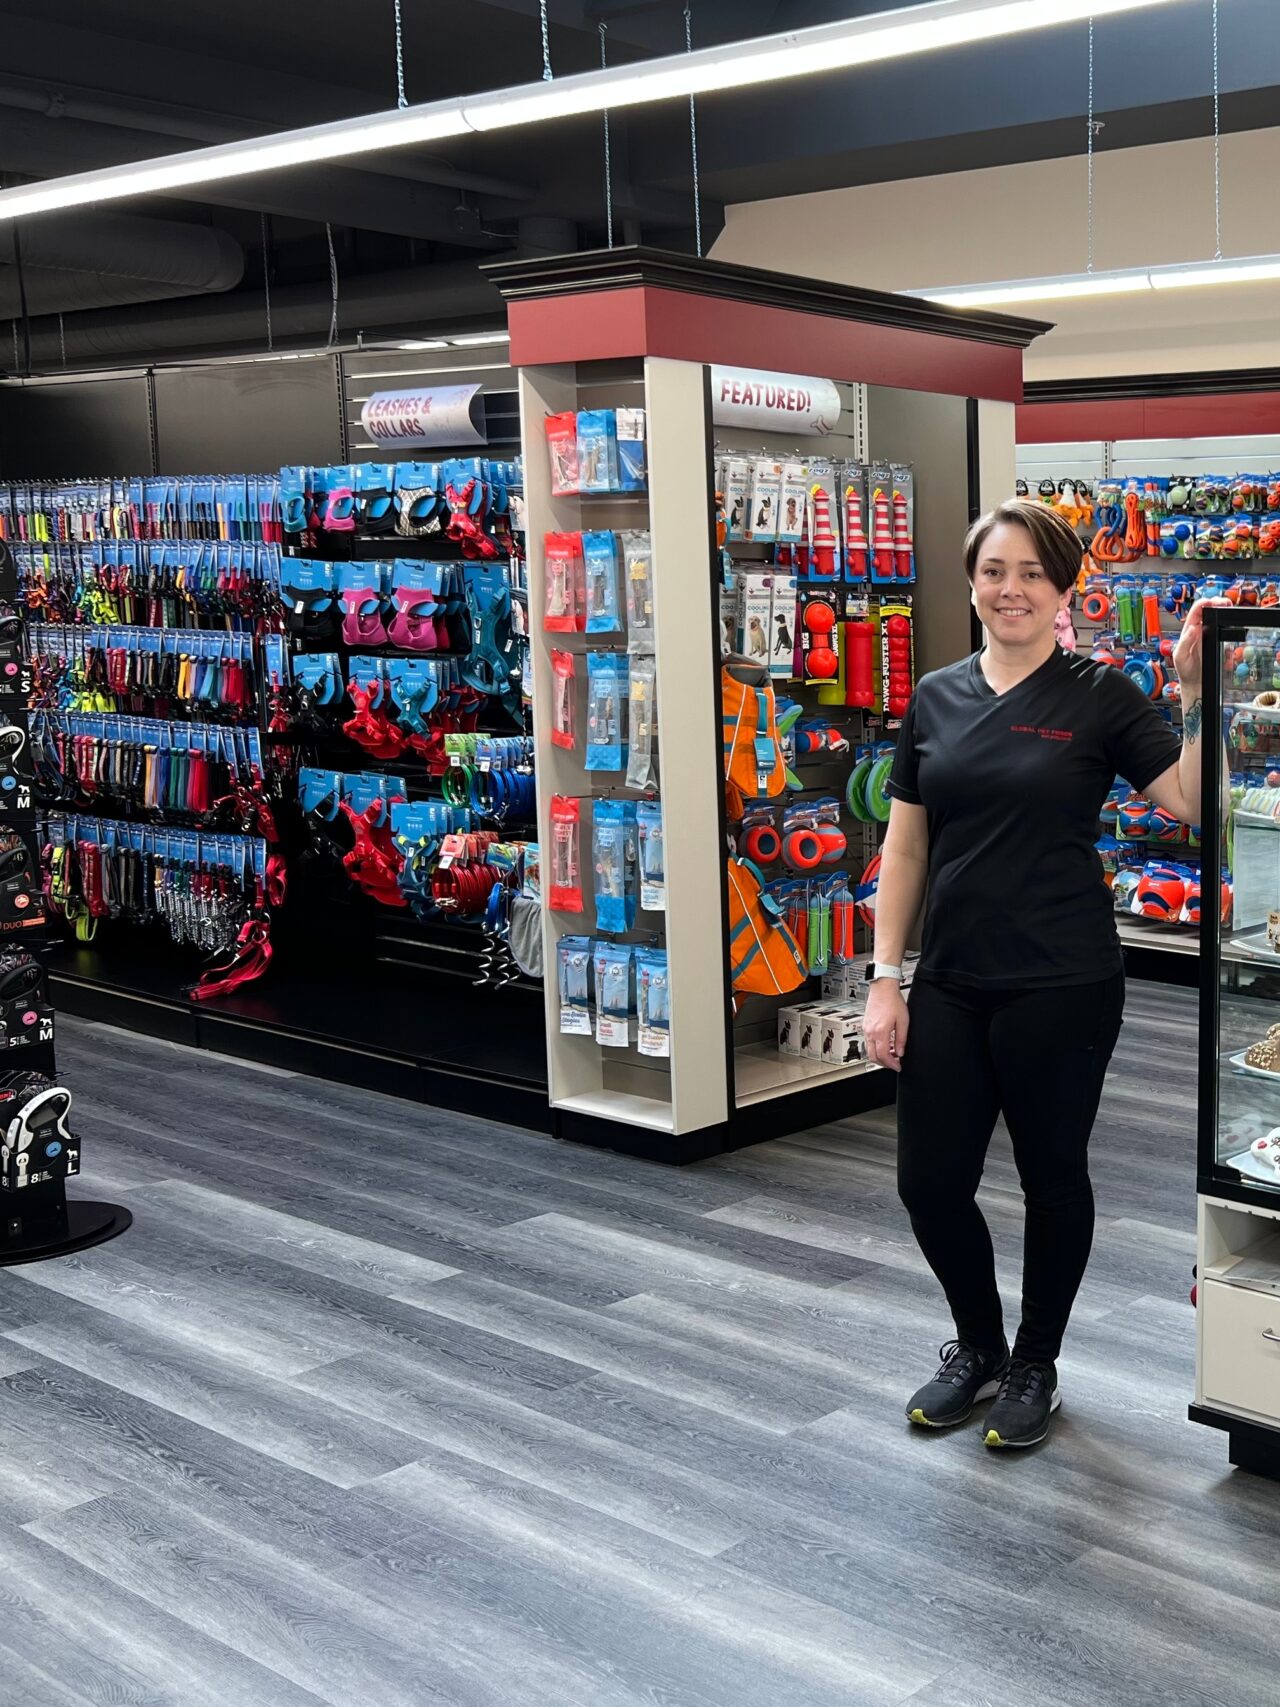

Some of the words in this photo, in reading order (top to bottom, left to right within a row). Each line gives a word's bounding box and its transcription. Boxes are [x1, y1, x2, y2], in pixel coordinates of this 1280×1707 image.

[720, 380, 811, 413] FEATURED!
[368, 397, 421, 417] LEASHES
[422, 397, 432, 414] &
[369, 418, 426, 439] COLLARS
[881, 620, 888, 636] XL
[802, 632, 810, 649] BIG
[20, 680, 31, 693] S
[16, 796, 30, 809] M
[3, 920, 22, 930] DUO
[39, 1028, 53, 1041] M
[9, 1036, 17, 1047] 5
[67, 1161, 77, 1174] L
[30, 1173, 39, 1184] 8
